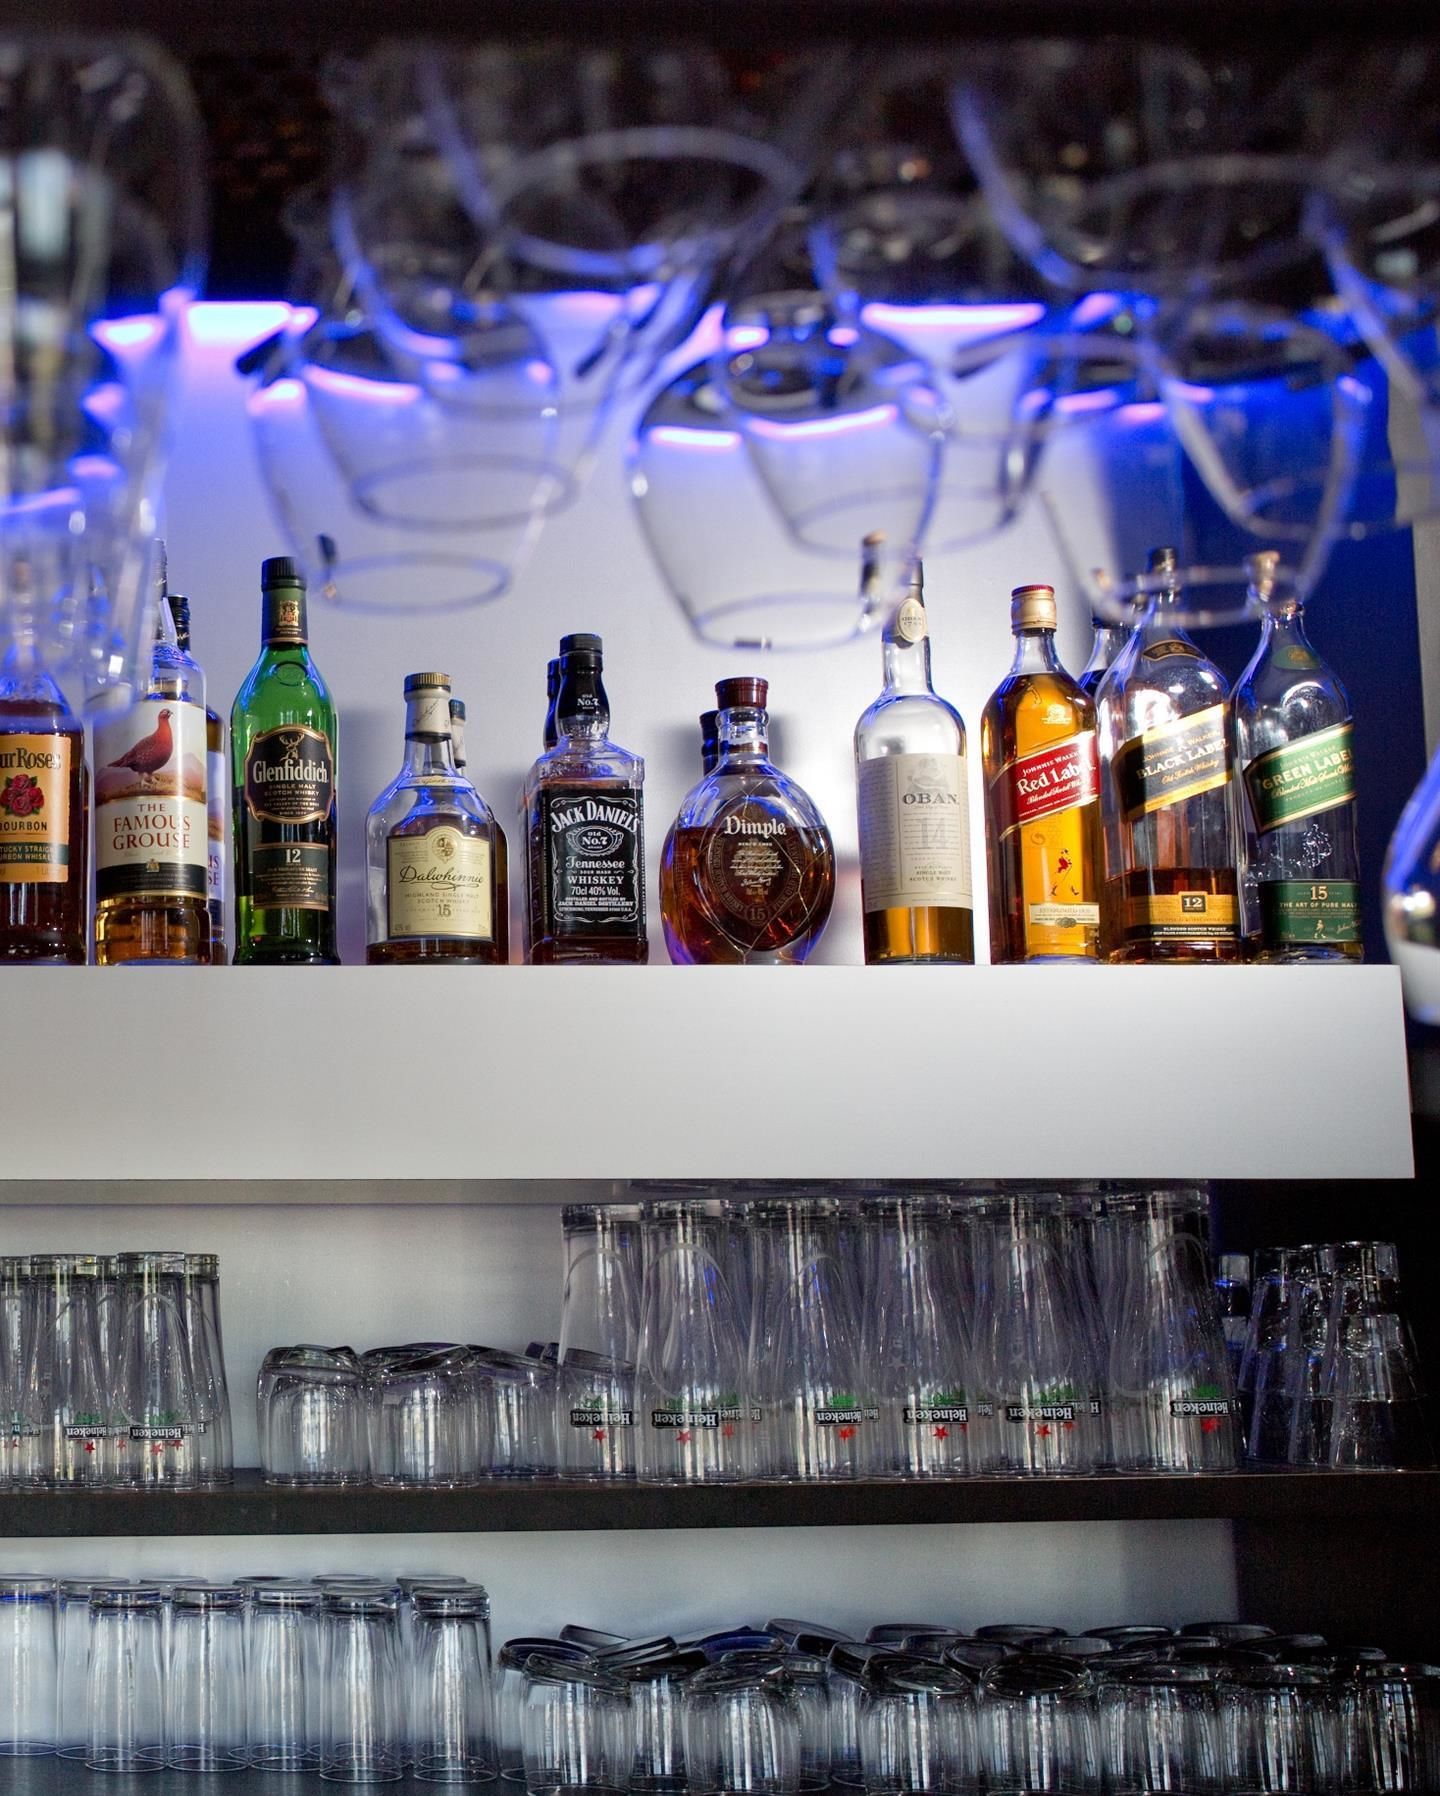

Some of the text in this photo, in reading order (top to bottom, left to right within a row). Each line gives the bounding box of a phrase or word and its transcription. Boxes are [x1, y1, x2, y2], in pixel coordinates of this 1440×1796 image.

[16, 747, 61, 770] Roses
[1136, 738, 1227, 780] BLACK LABEL
[252, 758, 328, 784] Glenfiddich
[1262, 763, 1312, 789] GREEN
[1016, 771, 1051, 797] Red
[903, 793, 957, 804] OBAN
[137, 803, 166, 812] THE
[550, 800, 639, 833] JACK DANIEL'S
[114, 815, 191, 833] FAMOUS
[915, 817, 948, 849] 14
[112, 832, 191, 851] GROUSE
[582, 836, 608, 846] No.7
[285, 848, 301, 863] 12
[565, 856, 625, 869] Tennessee
[399, 865, 483, 885] Dalwhinnie
[567, 876, 624, 885] WHISKEY
[571, 886, 587, 895] 70cl
[588, 886, 605, 895] 40%
[1310, 886, 1328, 900] 15
[1183, 897, 1203, 908] 12
[1010, 1407, 1071, 1419] Heineken
[1174, 1402, 1228, 1414] Heineken
[573, 1412, 630, 1425] Heineken
[655, 1413, 716, 1426] Heineken
[817, 1411, 861, 1423] Heineken
[906, 1410, 966, 1421] Heineken
[66, 1427, 106, 1436] Heineken
[131, 1428, 182, 1438] Heineken
